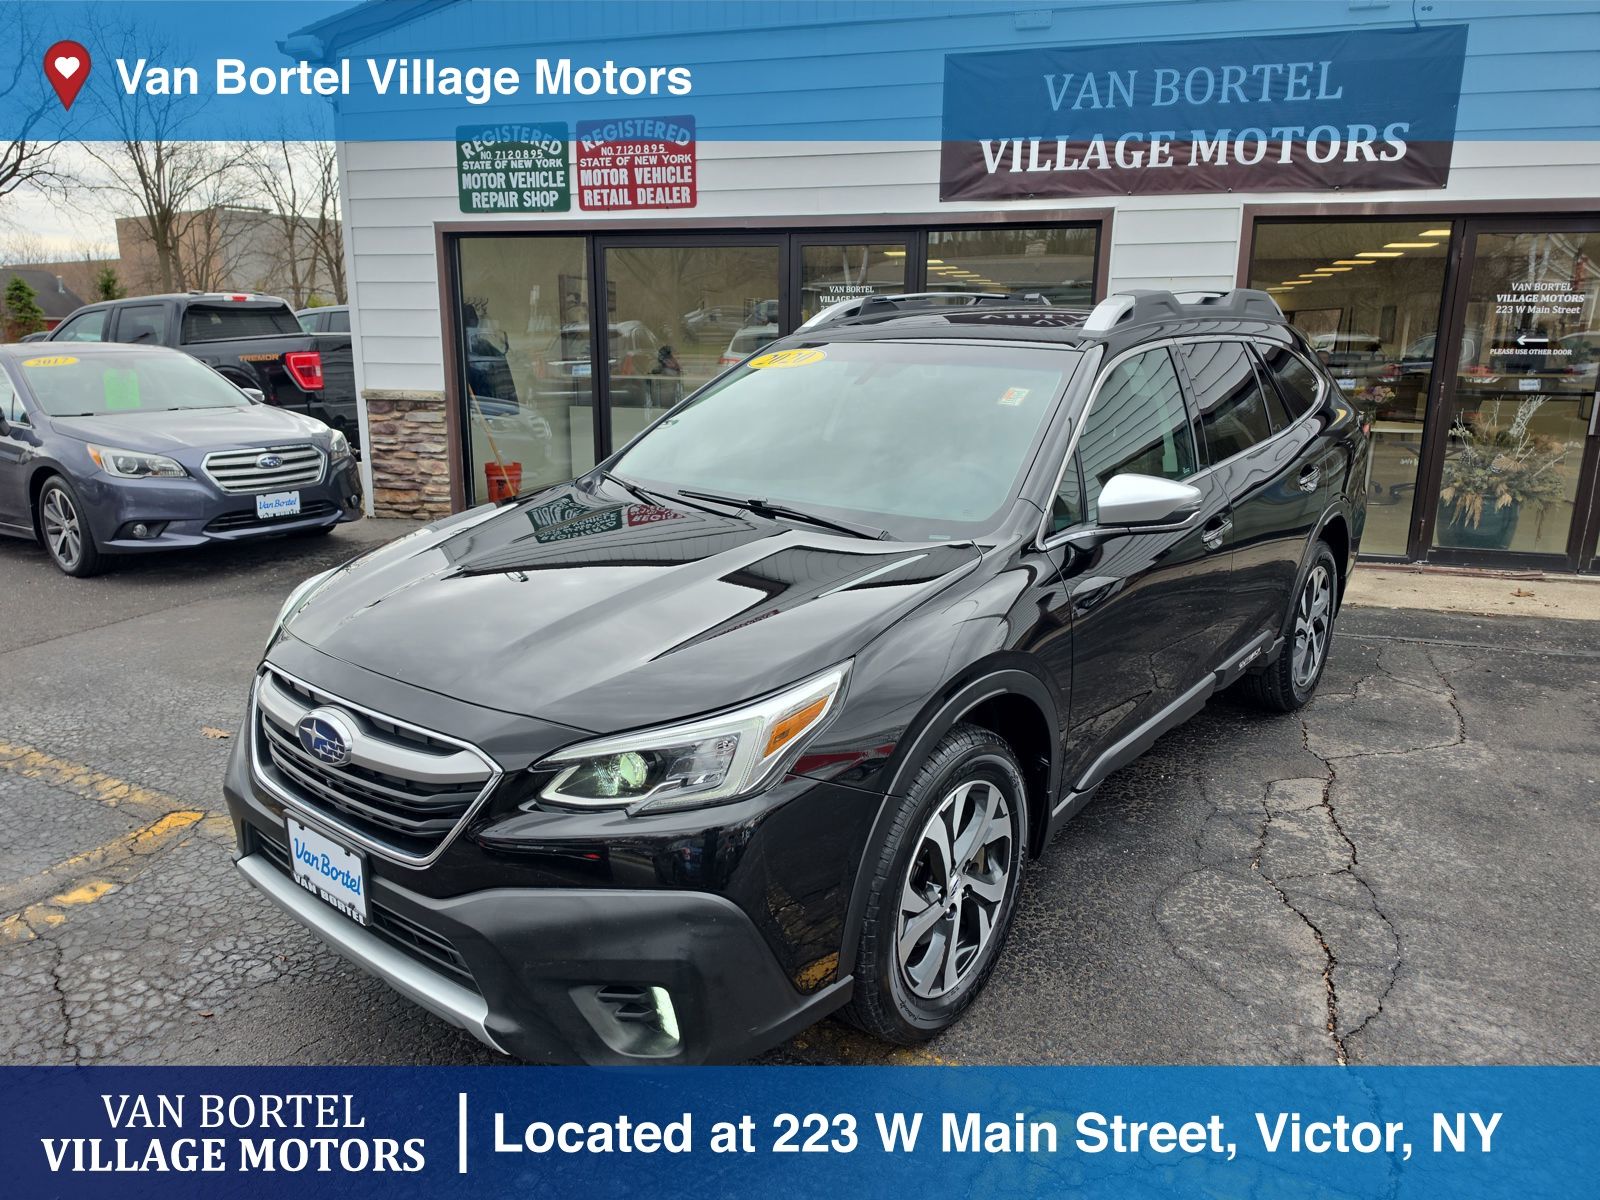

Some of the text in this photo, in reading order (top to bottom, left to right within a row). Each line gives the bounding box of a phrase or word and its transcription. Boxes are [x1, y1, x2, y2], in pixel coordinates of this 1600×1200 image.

[1044, 60, 1343, 112] VAN BORTEL
[461, 125, 562, 159] REGISTERED
[580, 120, 691, 152] REGISTERED
[481, 149, 543, 160] NO. 7120895
[601, 144, 665, 156] NO. 7120895
[979, 122, 1410, 174] VILLAGE MOTORS
[462, 159, 563, 170] STATE OF NEW YORK
[580, 154, 692, 167] STATE OF NEW YORK
[462, 171, 565, 189] MOTOR VEHICLE
[580, 166, 692, 186] MOTOR VEHICLE
[472, 190, 559, 208] REPAIR SHOP
[584, 186, 691, 206] RETAIL DEALER
[1511, 282, 1573, 291] VAN BORTEL
[1496, 294, 1585, 303] VILLAGE MOTORS
[1496, 305, 1581, 314] 223 W Main Street
[239, 353, 280, 362] TREMOR
[293, 873, 366, 926] VAN BORTEL
